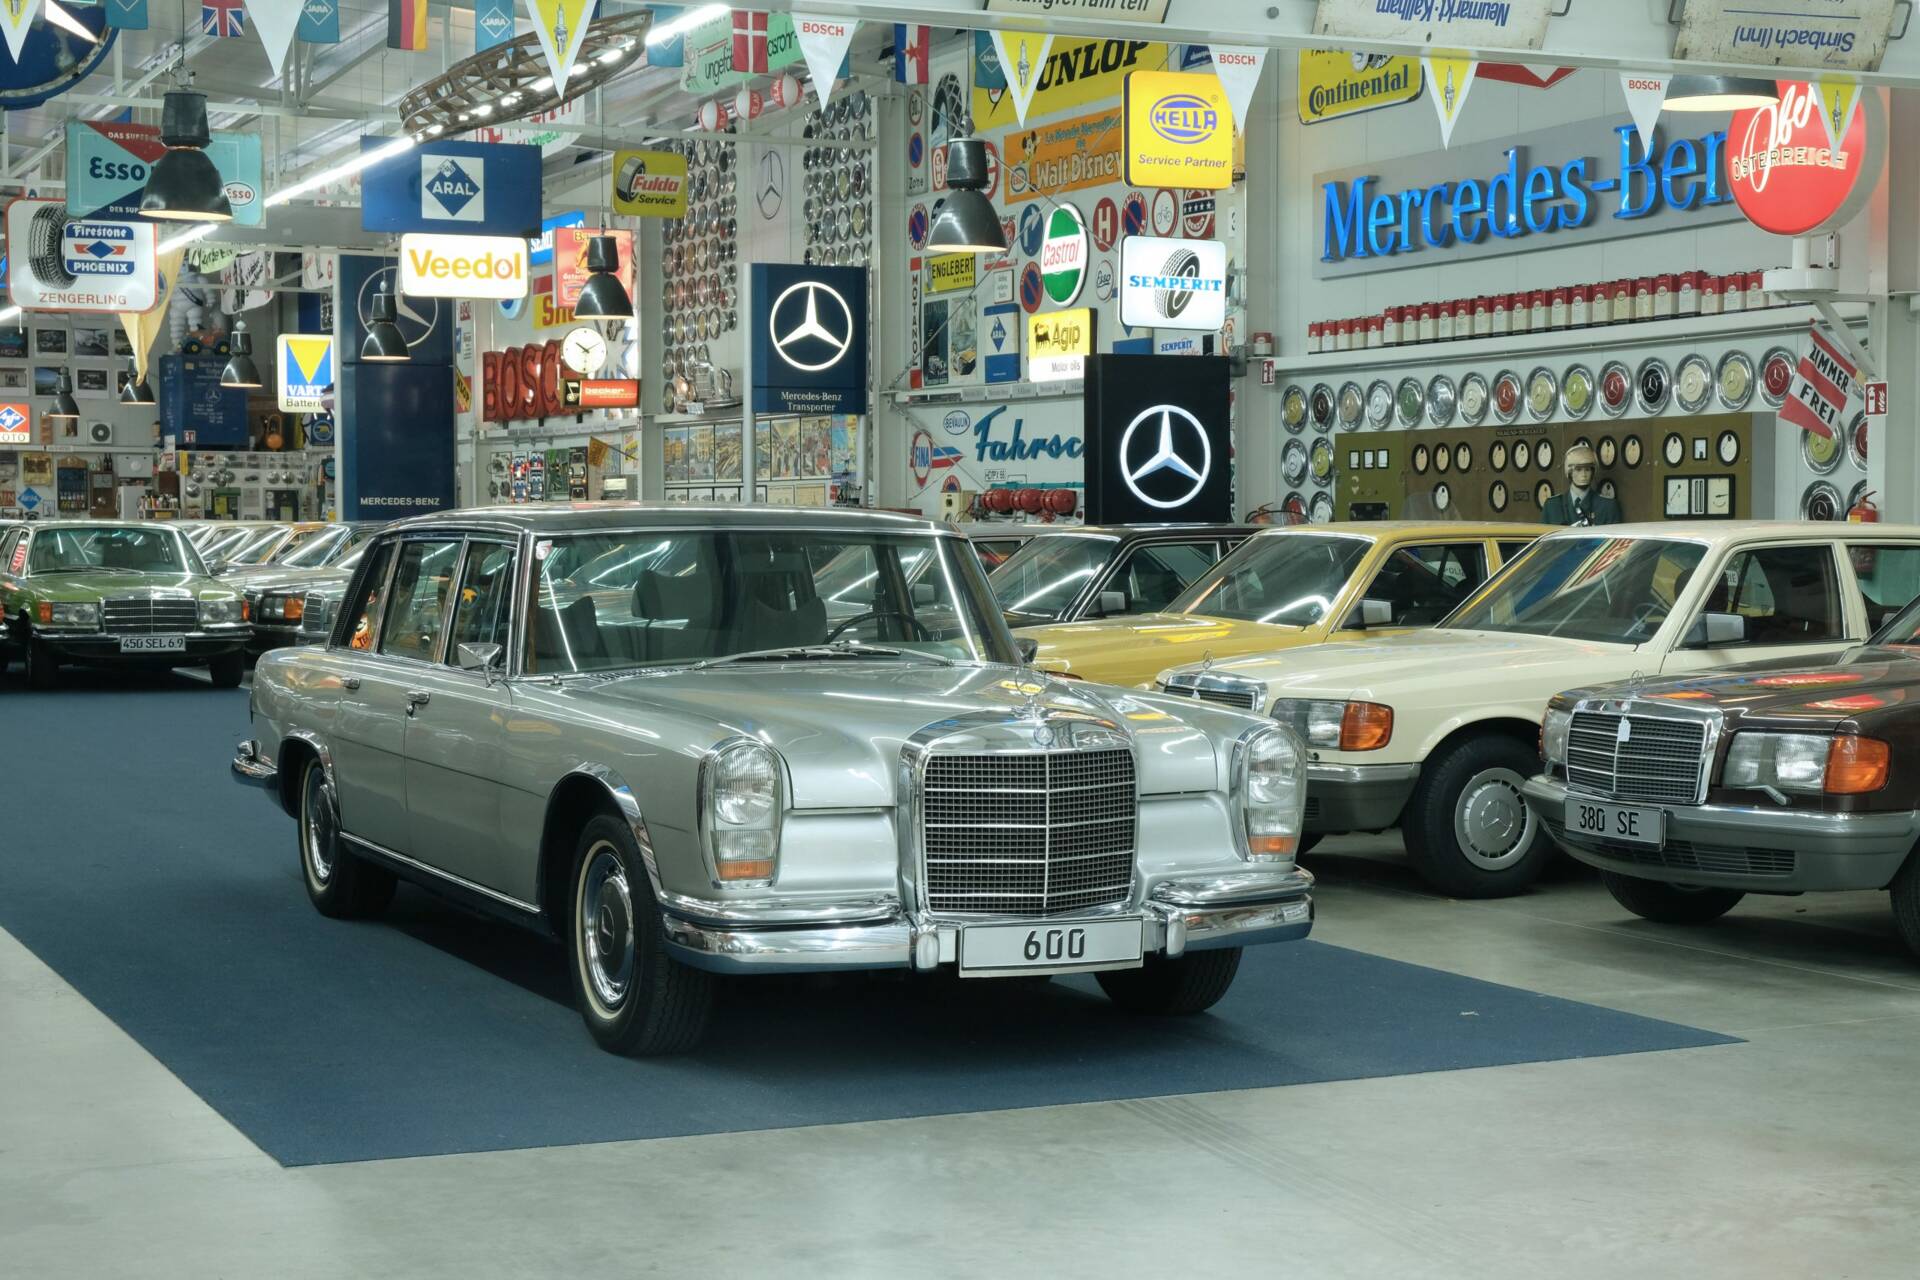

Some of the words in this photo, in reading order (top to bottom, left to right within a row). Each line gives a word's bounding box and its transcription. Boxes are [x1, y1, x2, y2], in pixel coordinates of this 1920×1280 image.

[802, 22, 845, 37] BOSCH
[1732, 25, 1773, 49] (Inn)
[1775, 28, 1856, 53] Simbach
[1036, 39, 1150, 92] UNLOP
[1219, 54, 1256, 65] BOSCH
[1308, 63, 1409, 116] Continental
[1628, 79, 1661, 91] BOSCH
[1154, 110, 1218, 131] HELLA
[108, 131, 124, 140] DAS
[1138, 153, 1181, 167] Service
[1184, 156, 1228, 169] Partner
[1036, 155, 1069, 190] Walt
[1070, 150, 1122, 183] Disney
[432, 180, 474, 196] ARAL
[632, 175, 680, 193] Fulda
[637, 194, 677, 206] Service
[1320, 123, 1734, 264] Mercedes-Ben
[72, 225, 128, 238] Firestone
[1043, 238, 1081, 267] Castrol
[73, 262, 128, 273] PHOENIX
[409, 249, 521, 280] Veedol
[932, 256, 975, 279] ENGLEBERT
[1129, 275, 1222, 291] SEMPERIT
[39, 292, 127, 305] ZENGERLING
[1051, 322, 1081, 352] Agip
[1160, 339, 1193, 352] SEMPERIT
[1051, 361, 1068, 373] Motor
[1808, 342, 1850, 394] ZIMMER
[483, 338, 588, 422] BOSC
[287, 384, 327, 397] VART
[780, 391, 843, 402] Mercedes-Benz
[787, 402, 837, 412] Transporter
[1799, 383, 1836, 425] FREI
[1, 432, 26, 442] OTO
[973, 404, 1085, 463] Fahrsc
[360, 497, 440, 506] MERCEDES-BENZ
[123, 638, 144, 649] 450
[145, 638, 166, 649] SEL
[1579, 804, 1606, 833] 380
[1616, 811, 1640, 837] SE
[1023, 928, 1086, 961] 600
